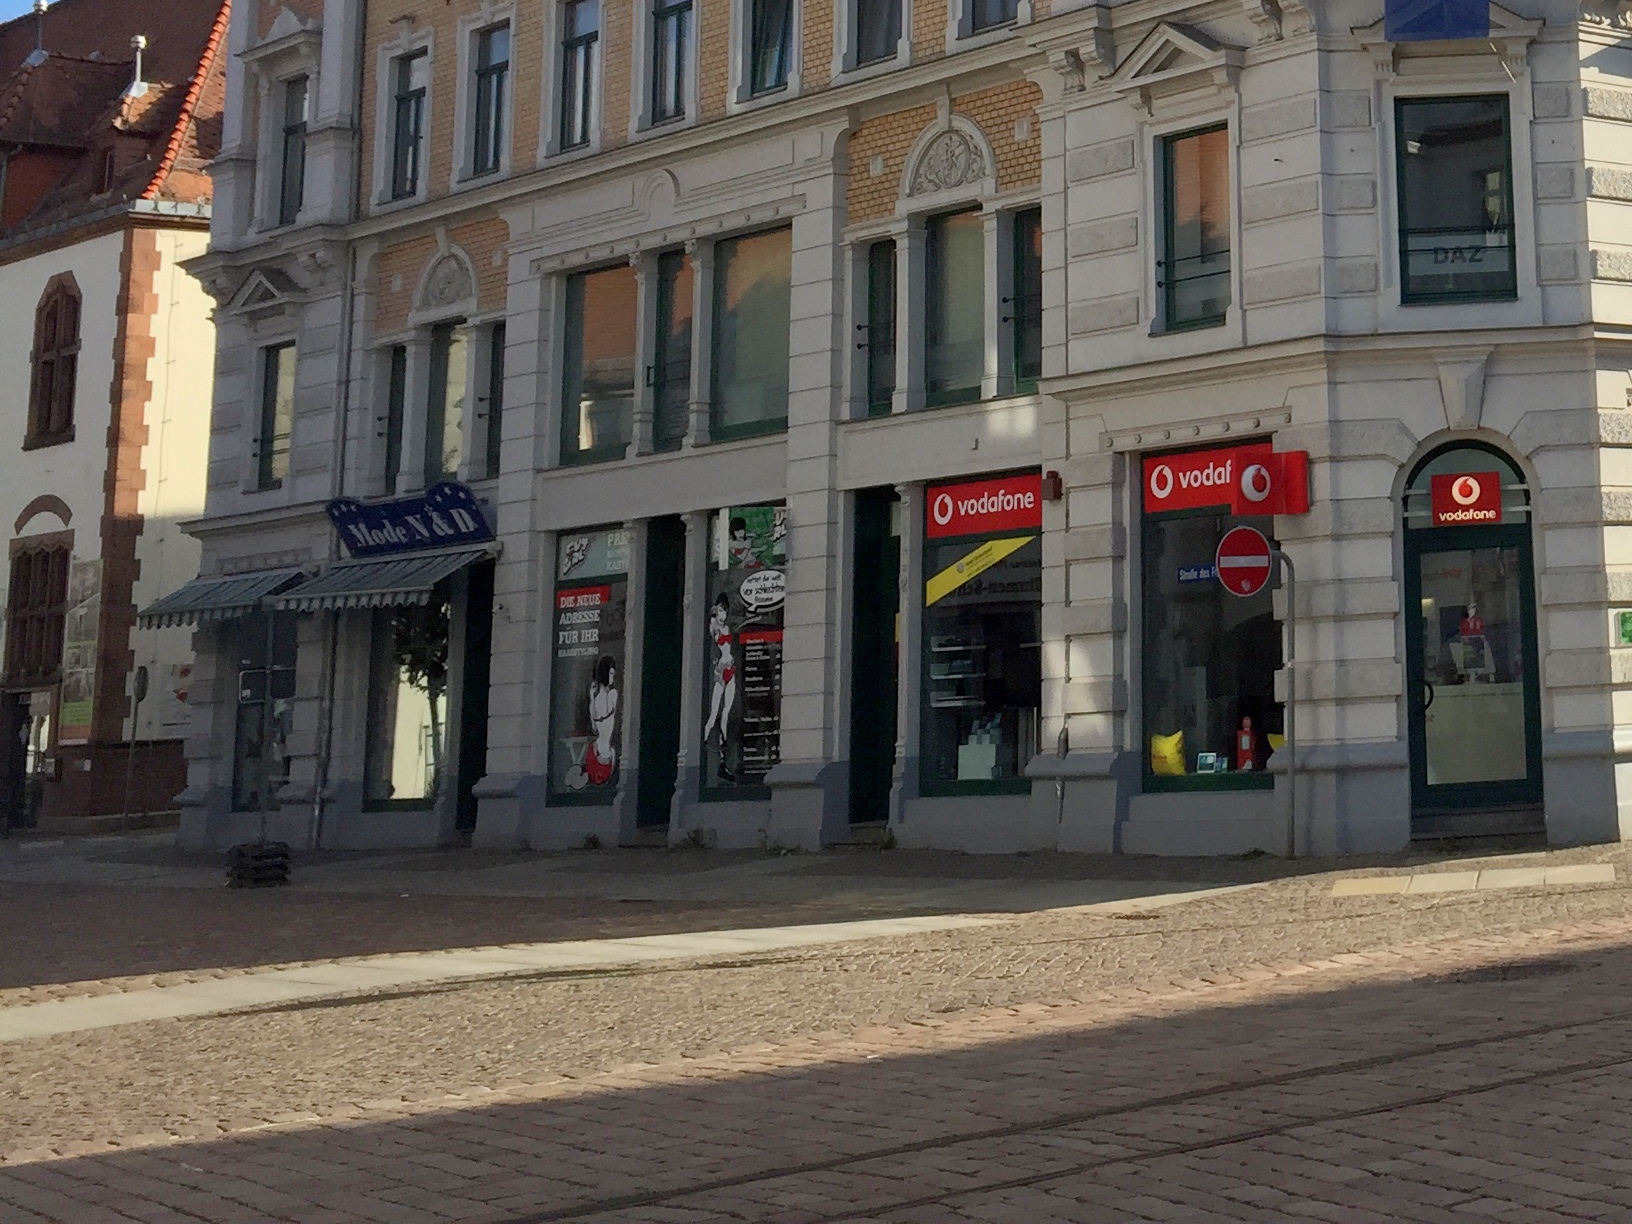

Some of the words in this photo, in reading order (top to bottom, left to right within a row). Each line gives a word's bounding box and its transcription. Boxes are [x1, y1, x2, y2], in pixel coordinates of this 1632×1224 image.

[1433, 245, 1483, 264] DAZ
[1178, 459, 1232, 489] vodaf
[957, 489, 1035, 516] vodafone
[1438, 508, 1497, 522] vodafone
[348, 519, 411, 547] Mode
[560, 596, 576, 609] DIE
[577, 593, 601, 607] NEUE
[559, 610, 600, 625] ADRESSE
[558, 626, 579, 645] FÜR
[580, 628, 600, 643] IHR
